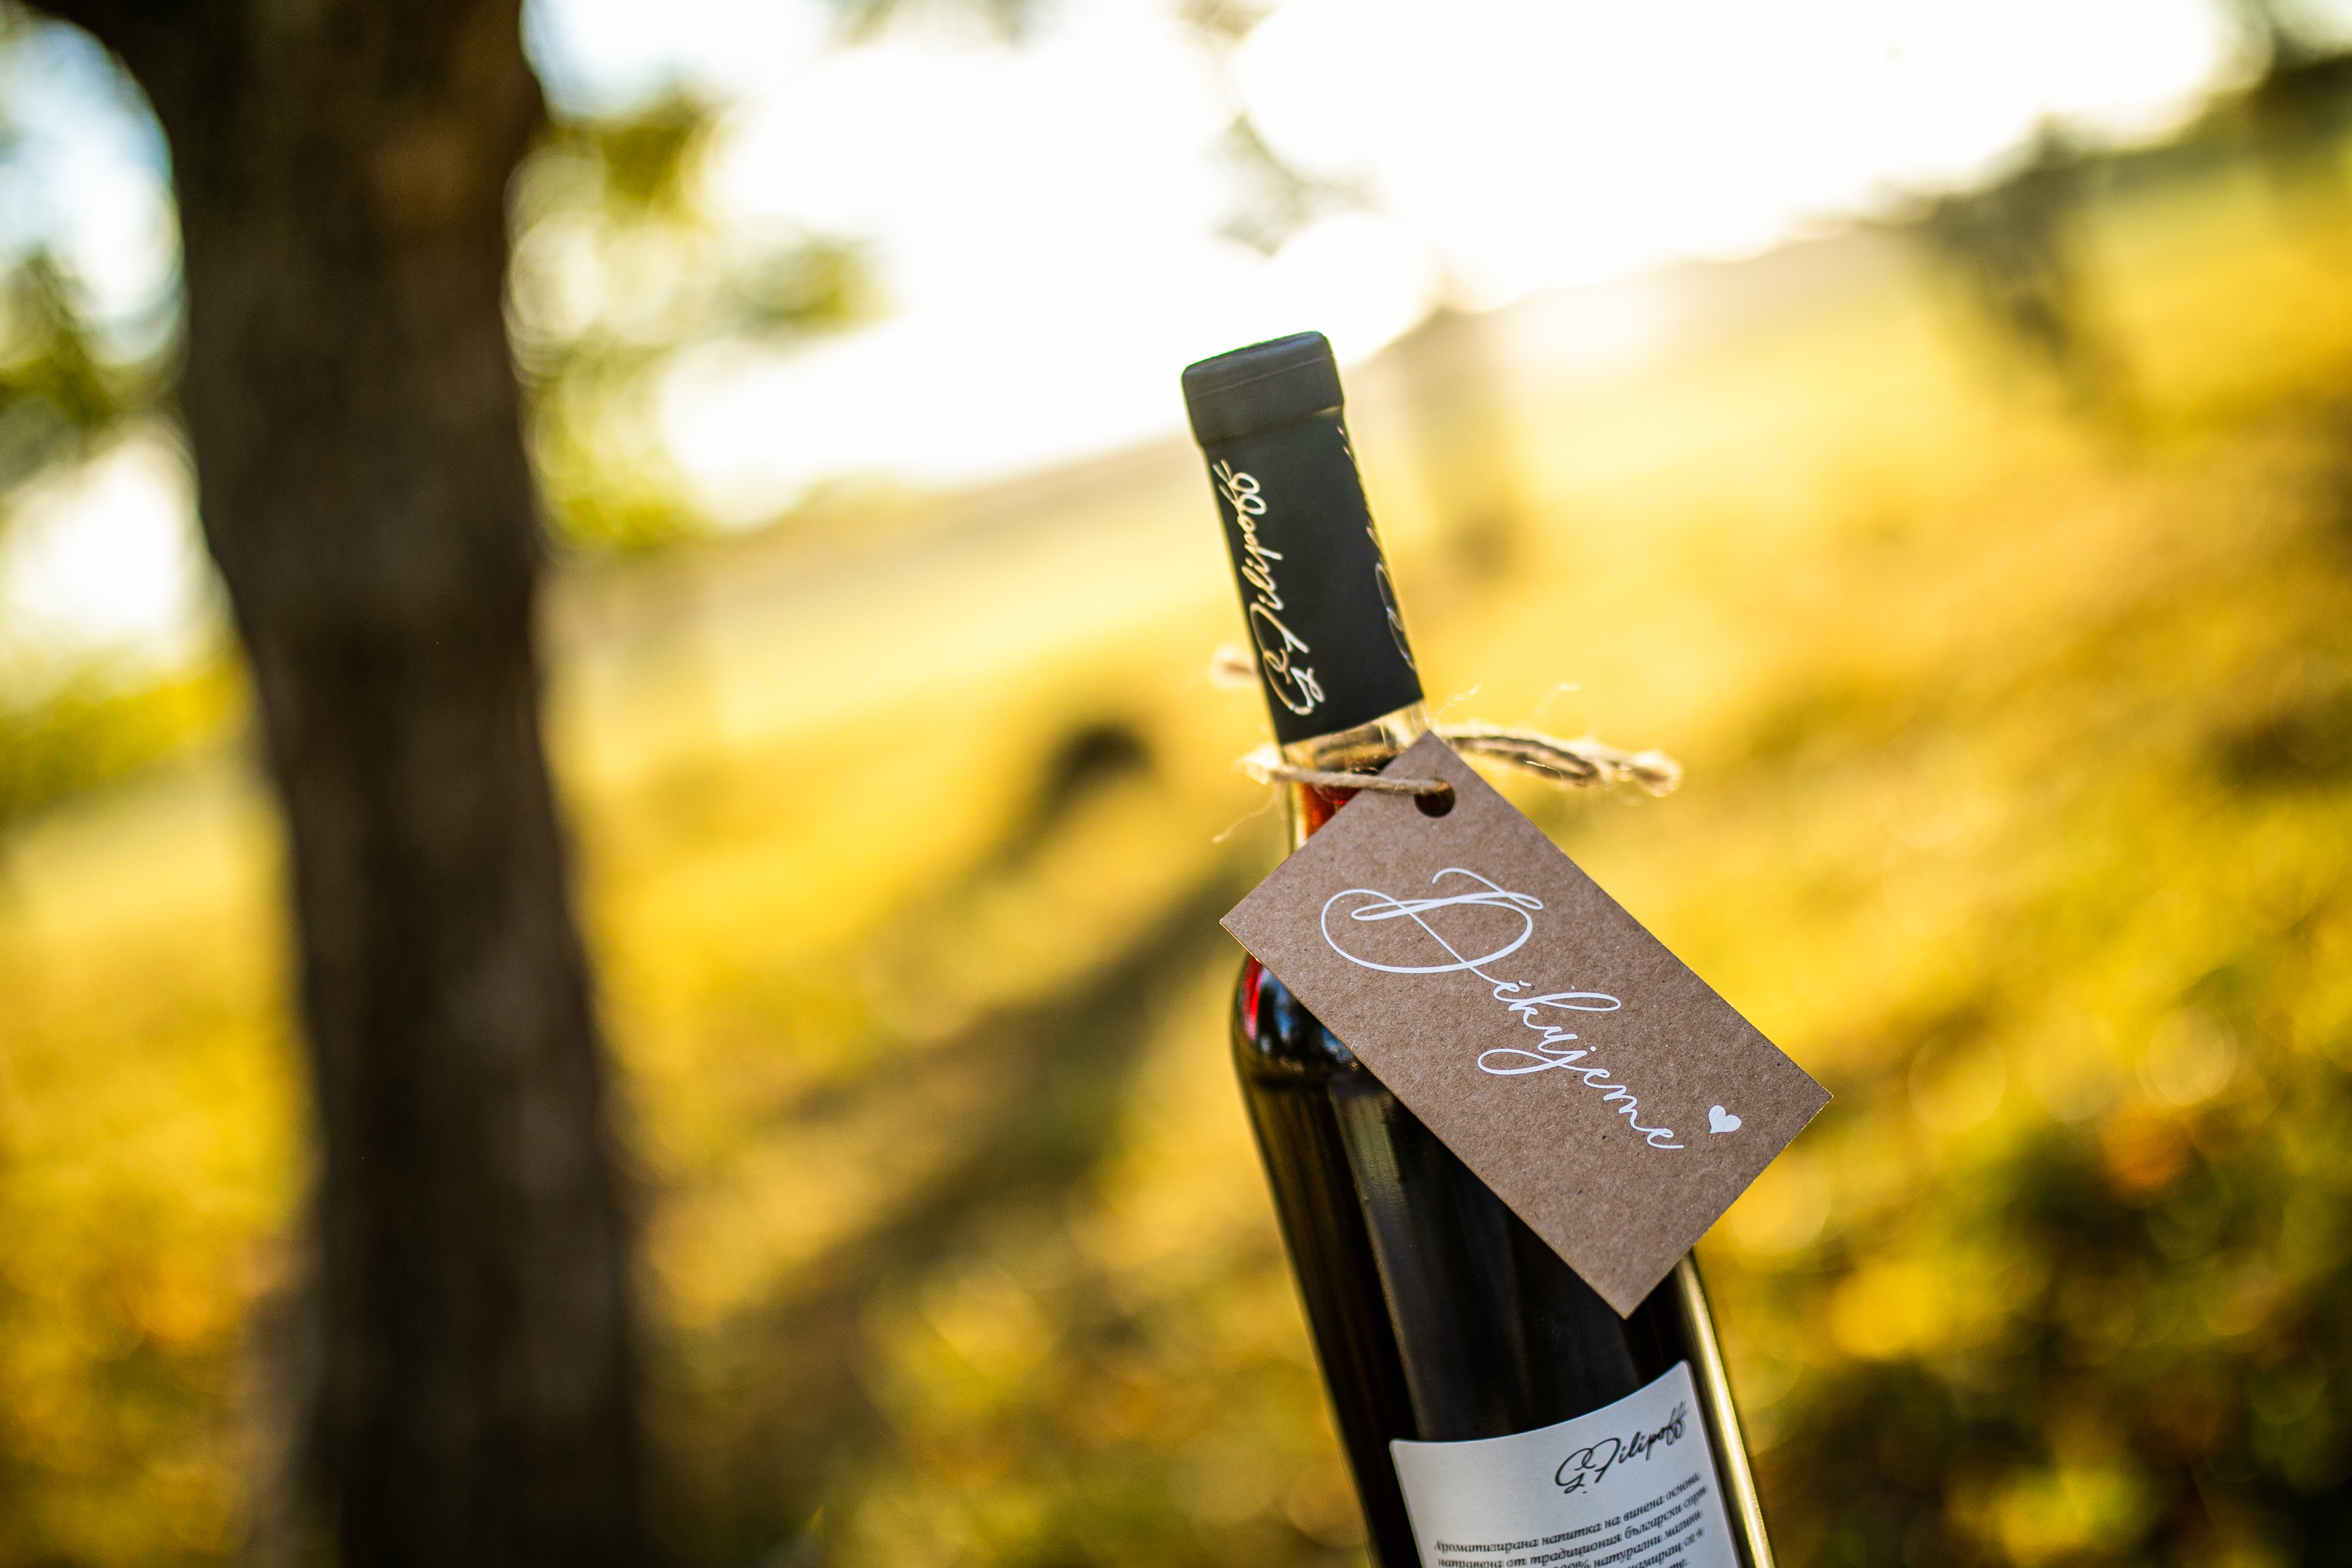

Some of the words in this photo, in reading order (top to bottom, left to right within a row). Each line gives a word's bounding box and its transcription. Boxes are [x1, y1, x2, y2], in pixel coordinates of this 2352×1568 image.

[1434, 1539, 1538, 1554] Ароматизирана
[1541, 1523, 1602, 1545] напитка
[1604, 1516, 1621, 1529] на
[1623, 1495, 1664, 1521] винена
[1506, 1557, 1527, 1567] от
[1625, 1504, 1681, 1539] български
[1594, 1535, 1662, 1568] натурални
